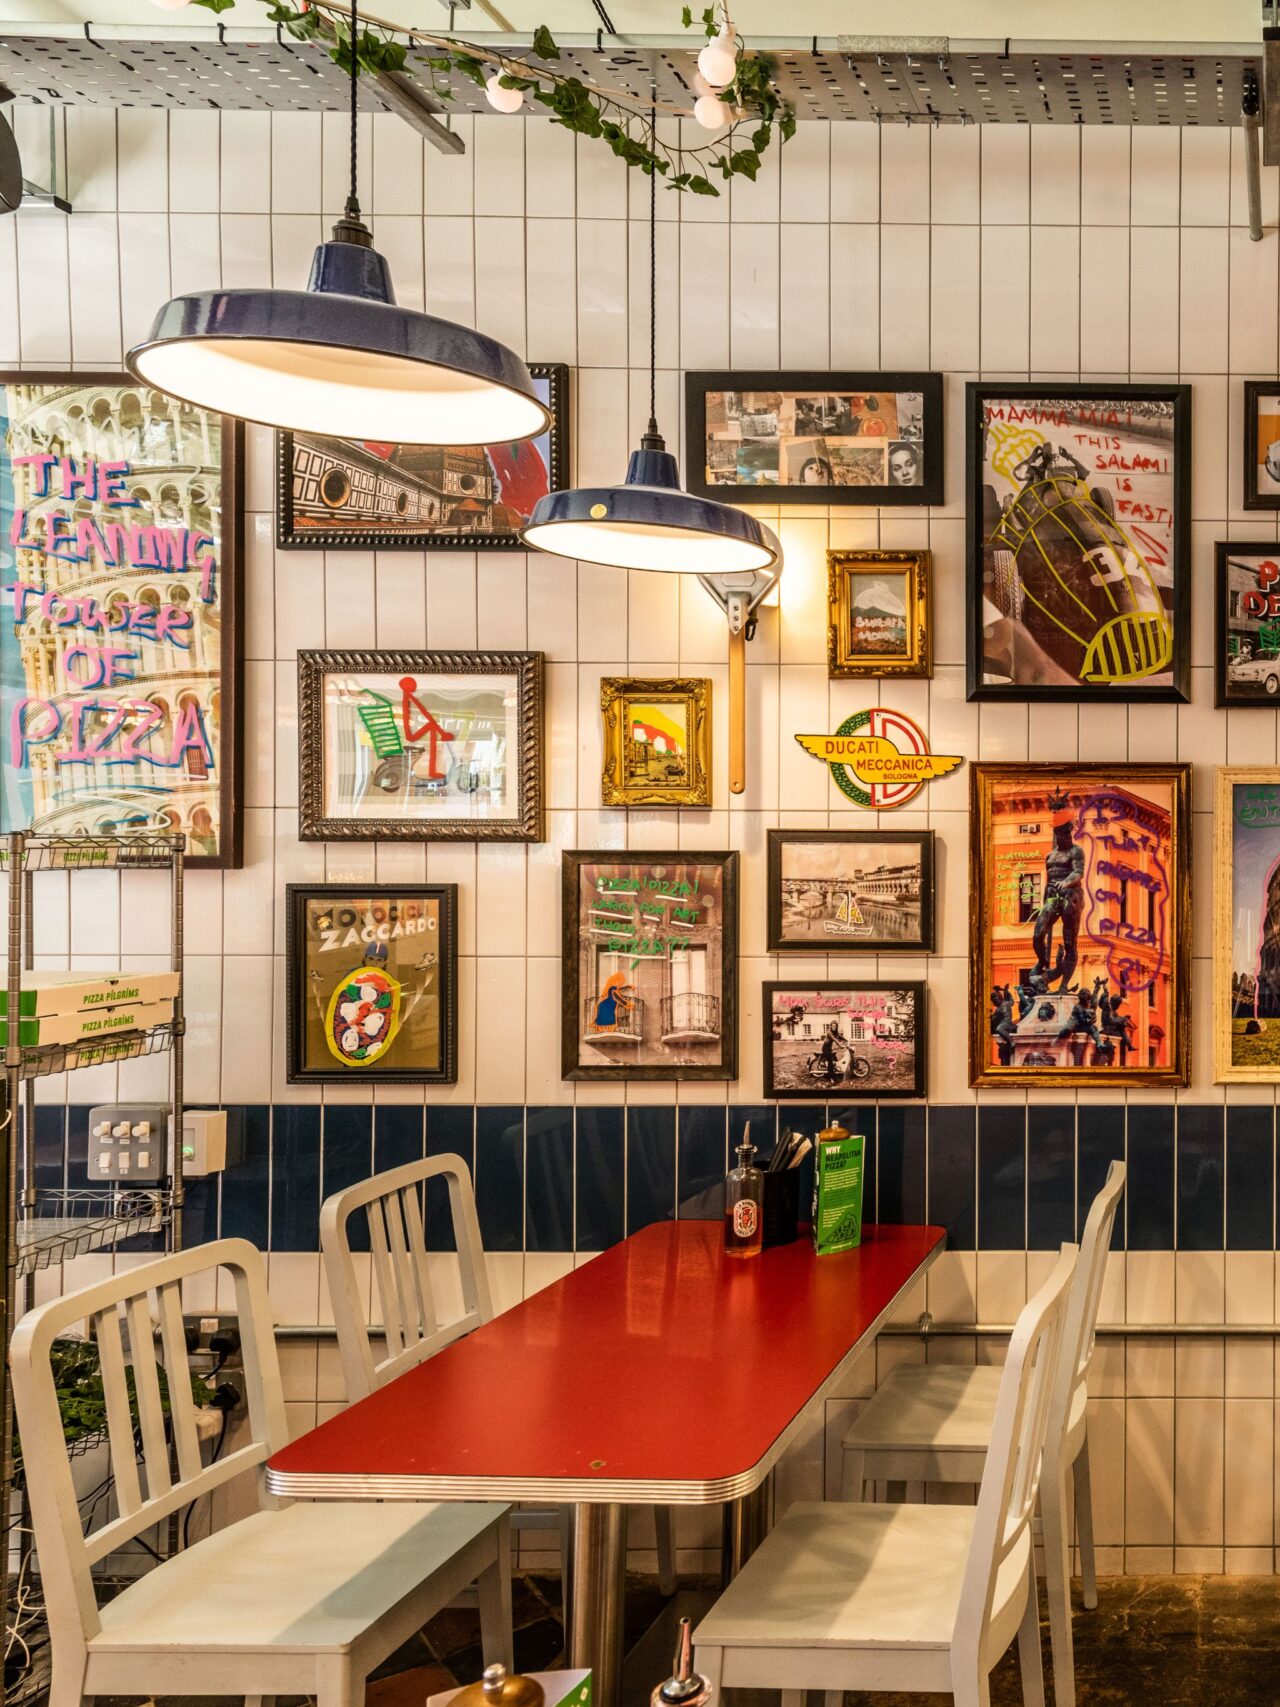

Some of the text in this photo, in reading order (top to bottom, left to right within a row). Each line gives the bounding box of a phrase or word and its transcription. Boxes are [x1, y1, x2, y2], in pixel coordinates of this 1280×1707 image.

[986, 406, 1071, 427] MAMMA
[1073, 434, 1121, 450] THIS
[1095, 455, 1168, 473] SALAMI
[13, 453, 141, 508] THE
[1117, 477, 1132, 492] IS
[1116, 499, 1173, 537] FAST!
[9, 509, 216, 603] LEANING
[6, 580, 194, 649] TOWER
[62, 643, 137, 690] OF
[10, 698, 214, 770] PIZZA
[825, 740, 879, 754] DUCATI
[856, 758, 933, 771] MECCANICA
[882, 772, 918, 780] BOLOGNA
[318, 917, 437, 952] ZACCARDO
[1099, 918, 1157, 948] PIZZA
[83, 988, 139, 1004] PIZZA PILGRIMS
[82, 1015, 134, 1032] PIZZA PILGRIMS
[825, 1145, 841, 1154] WHY
